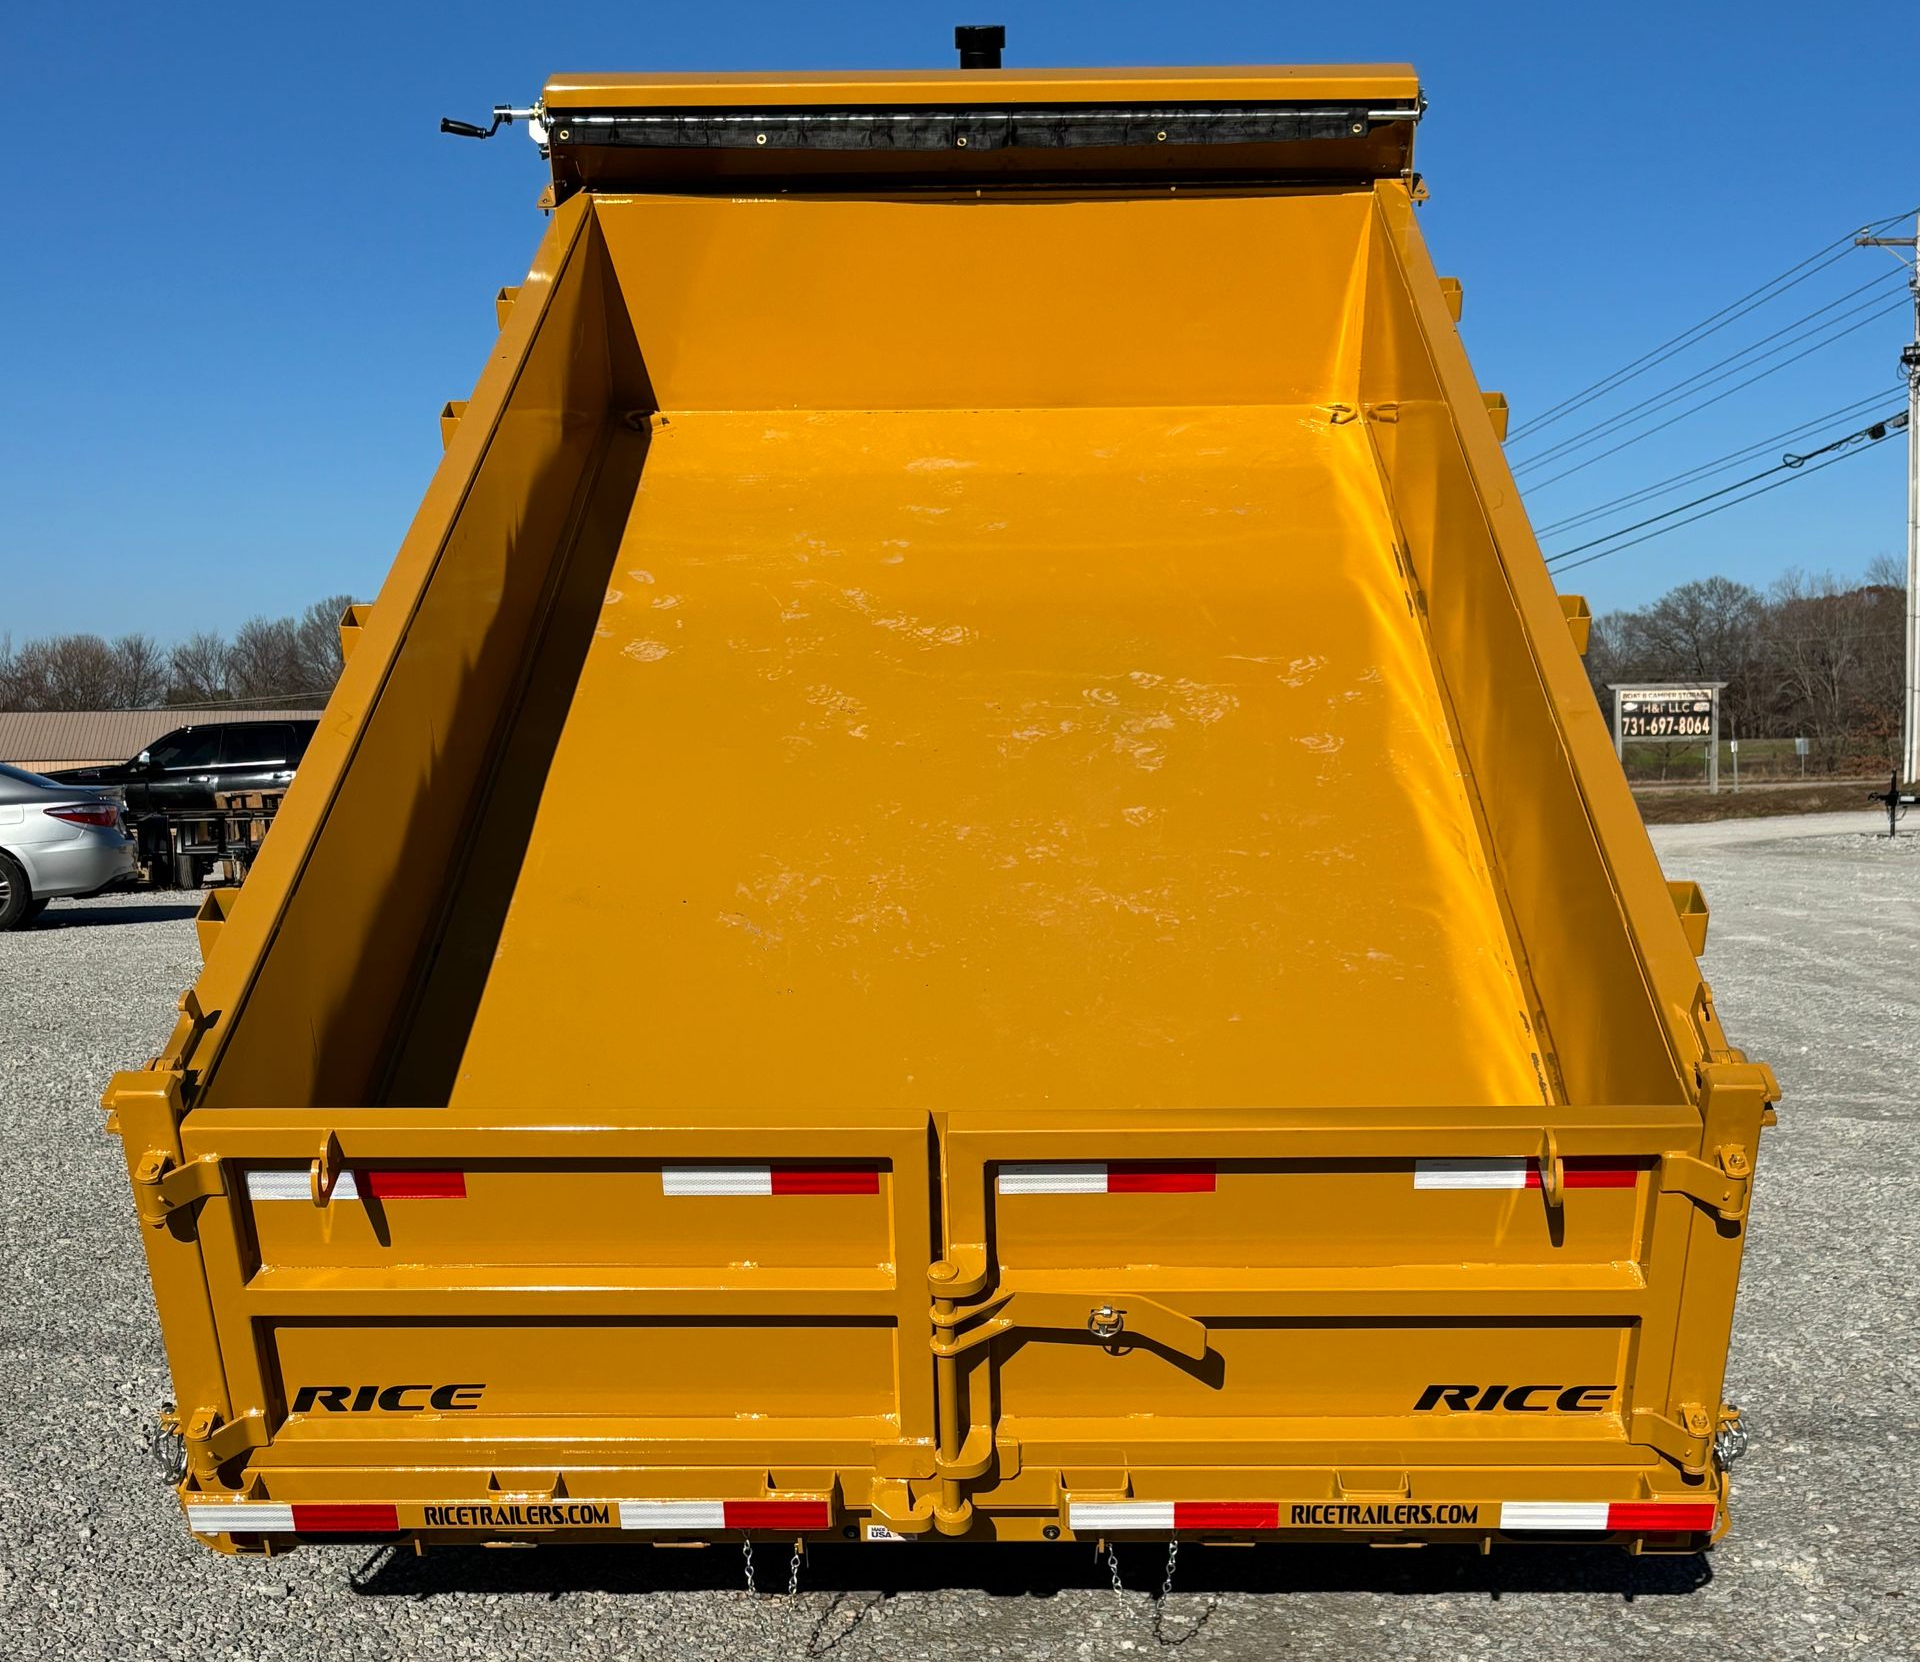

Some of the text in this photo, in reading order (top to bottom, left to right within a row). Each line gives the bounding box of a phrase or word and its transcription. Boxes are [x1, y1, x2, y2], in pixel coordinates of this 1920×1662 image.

[1668, 702, 1690, 713] LLC
[1622, 717, 1710, 735] 731-697-8064
[292, 1384, 486, 1412] RICE
[1413, 1385, 1617, 1411] RICE
[424, 1505, 609, 1526] RICETRAILERS.COM
[1291, 1505, 1478, 1524] RICETRAILERS.COM
